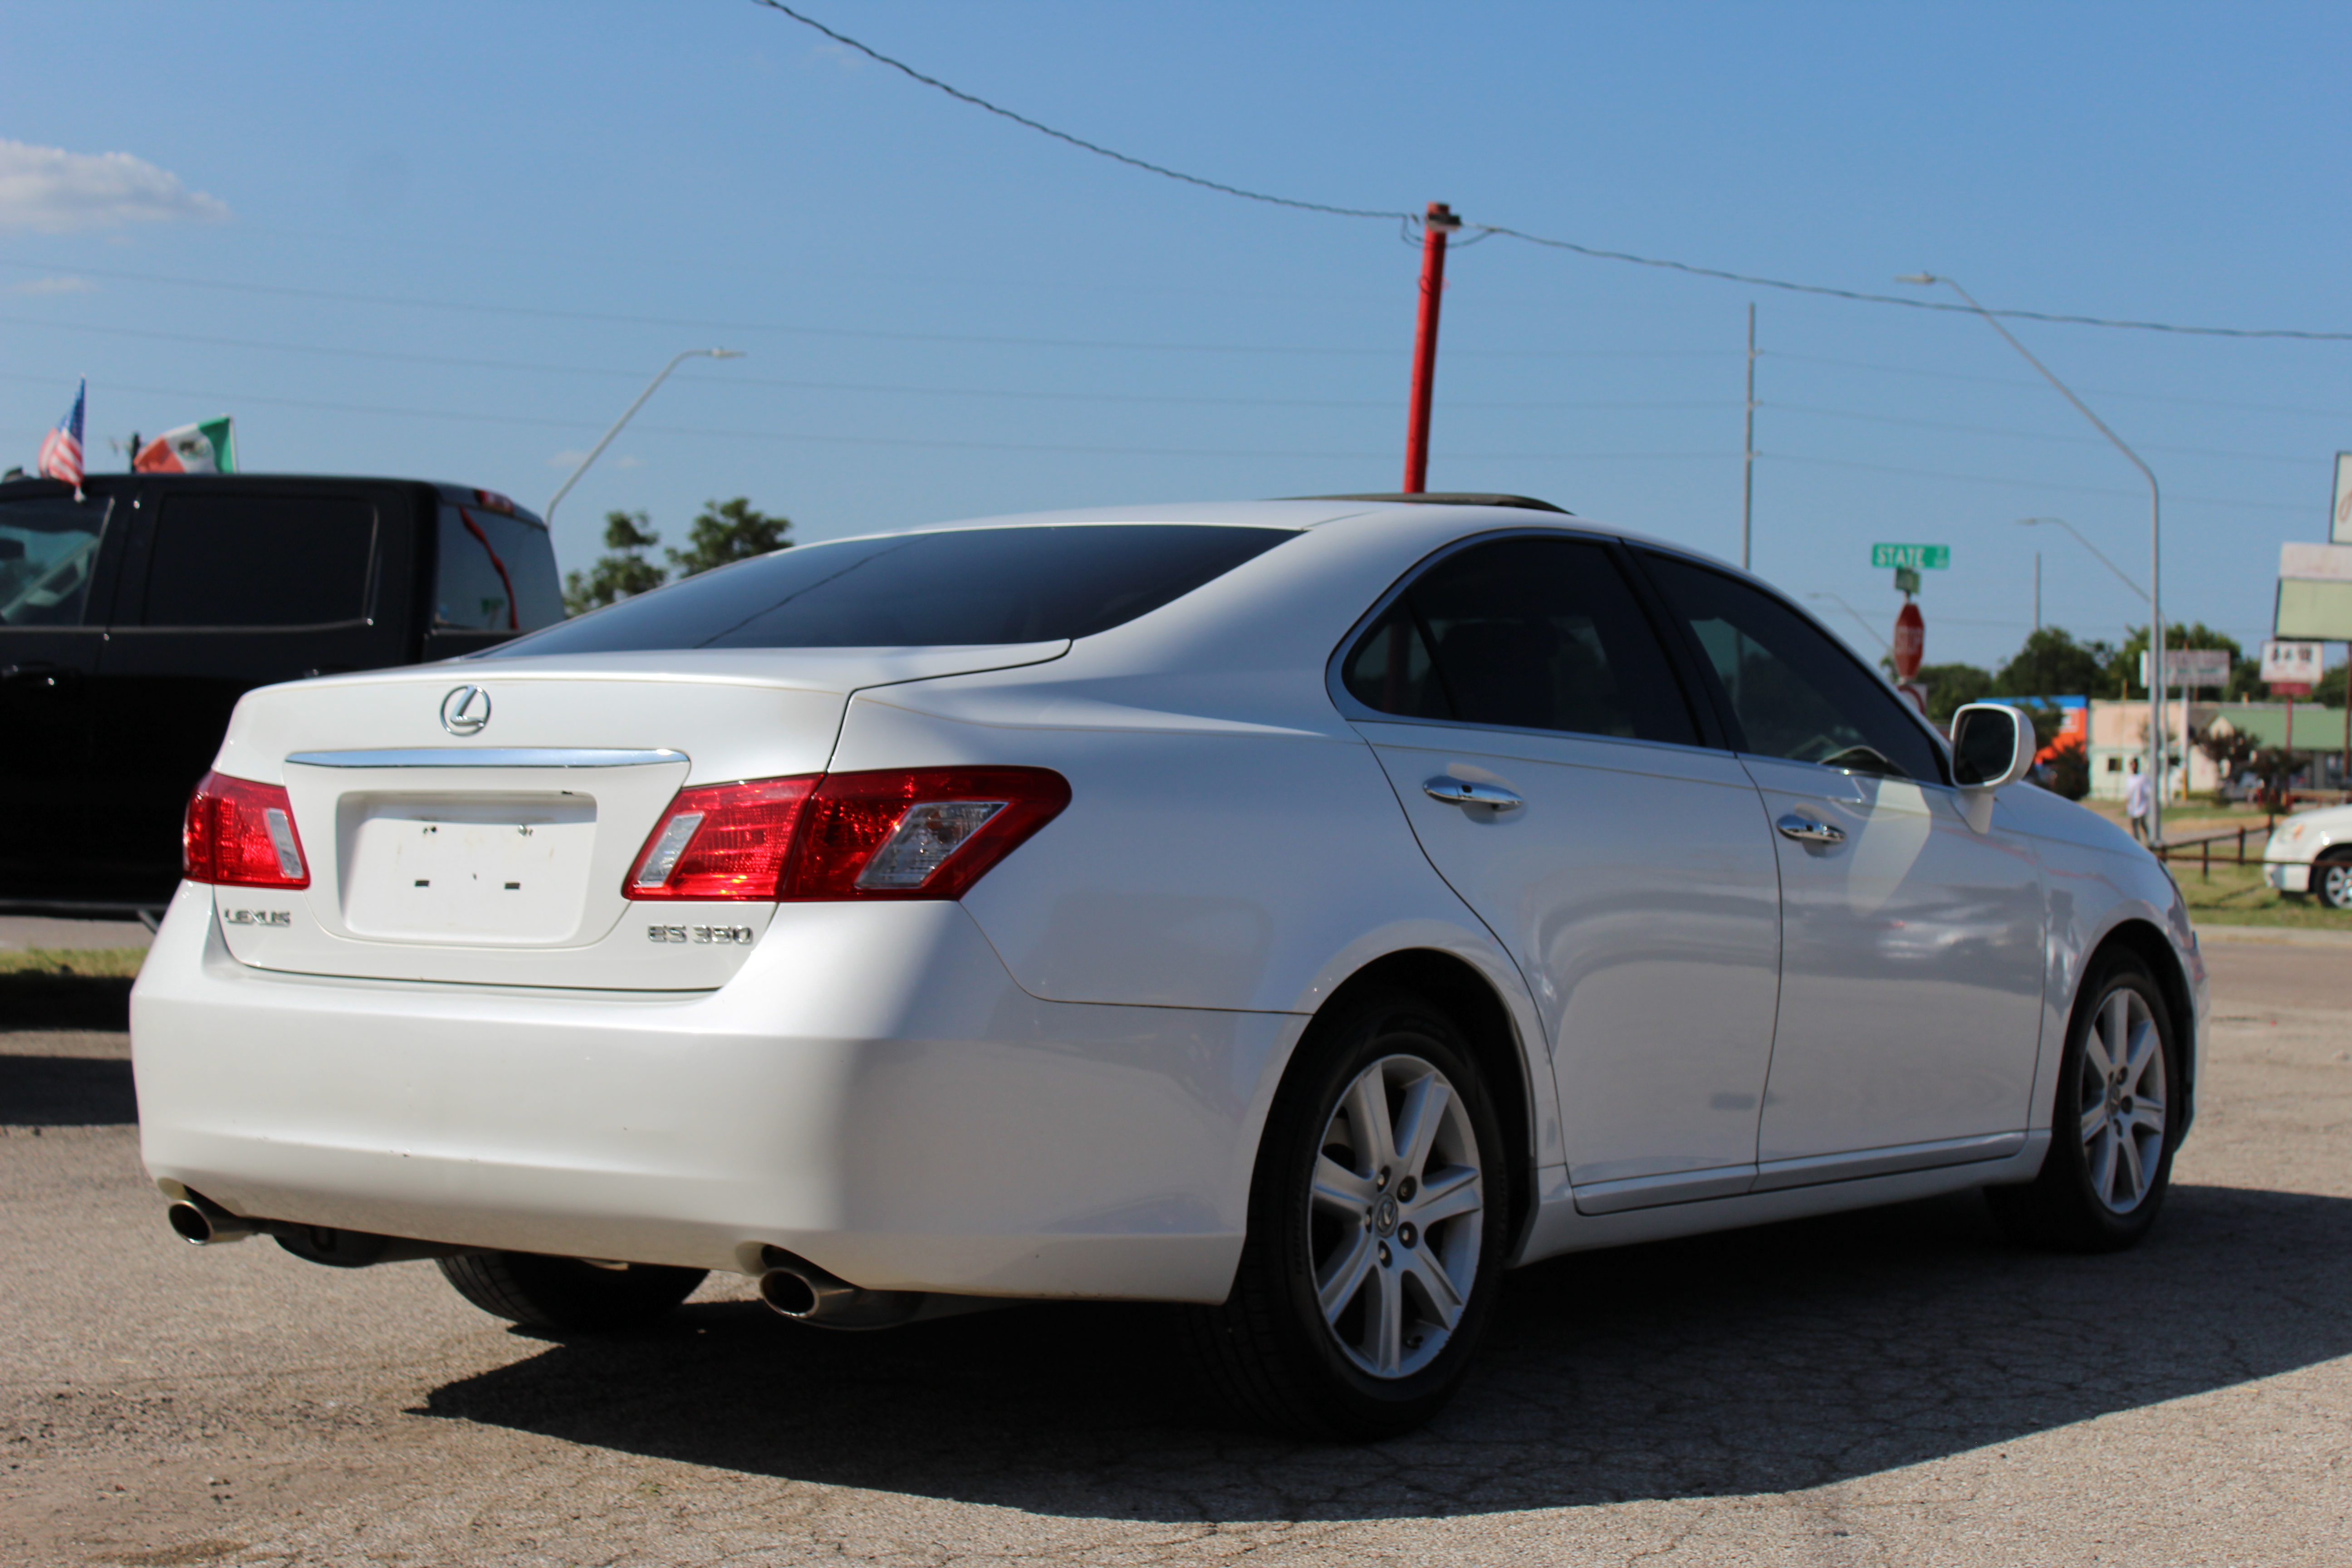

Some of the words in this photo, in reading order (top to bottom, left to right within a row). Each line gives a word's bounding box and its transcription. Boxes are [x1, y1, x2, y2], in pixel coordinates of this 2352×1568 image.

[1877, 547, 1925, 567] STATE
[224, 908, 291, 927] LEXUS
[648, 924, 687, 942] ES
[691, 924, 753, 944] 350
